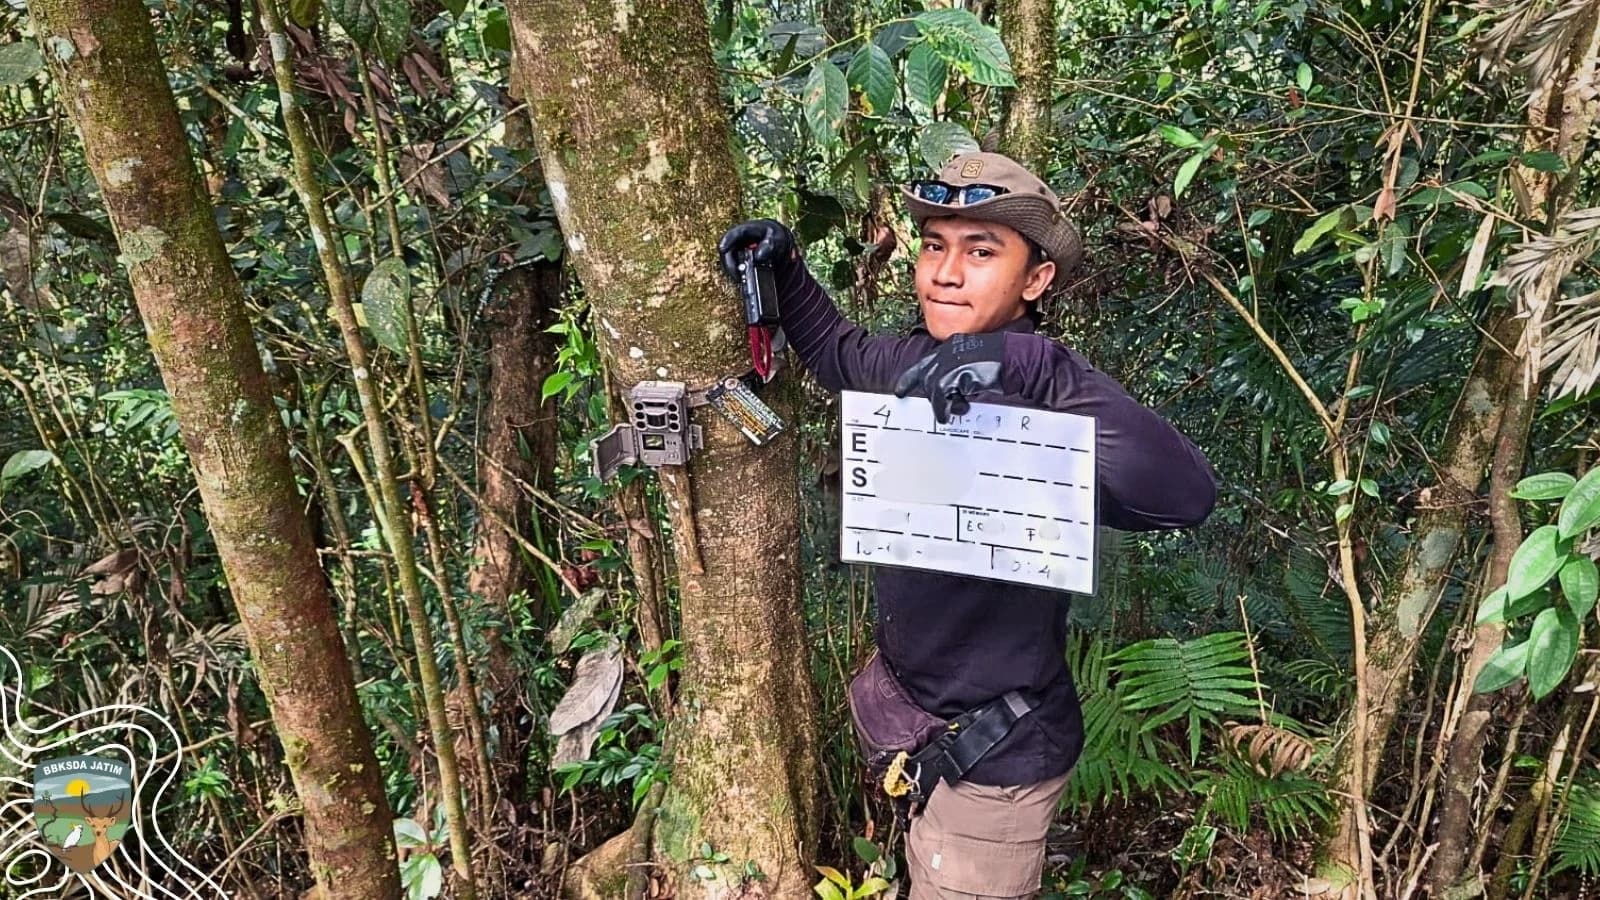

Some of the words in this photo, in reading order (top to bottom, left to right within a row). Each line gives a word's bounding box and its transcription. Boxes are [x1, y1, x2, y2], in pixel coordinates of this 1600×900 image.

[873, 404, 891, 426] 4
[852, 432, 867, 453] E
[851, 467, 868, 488] S
